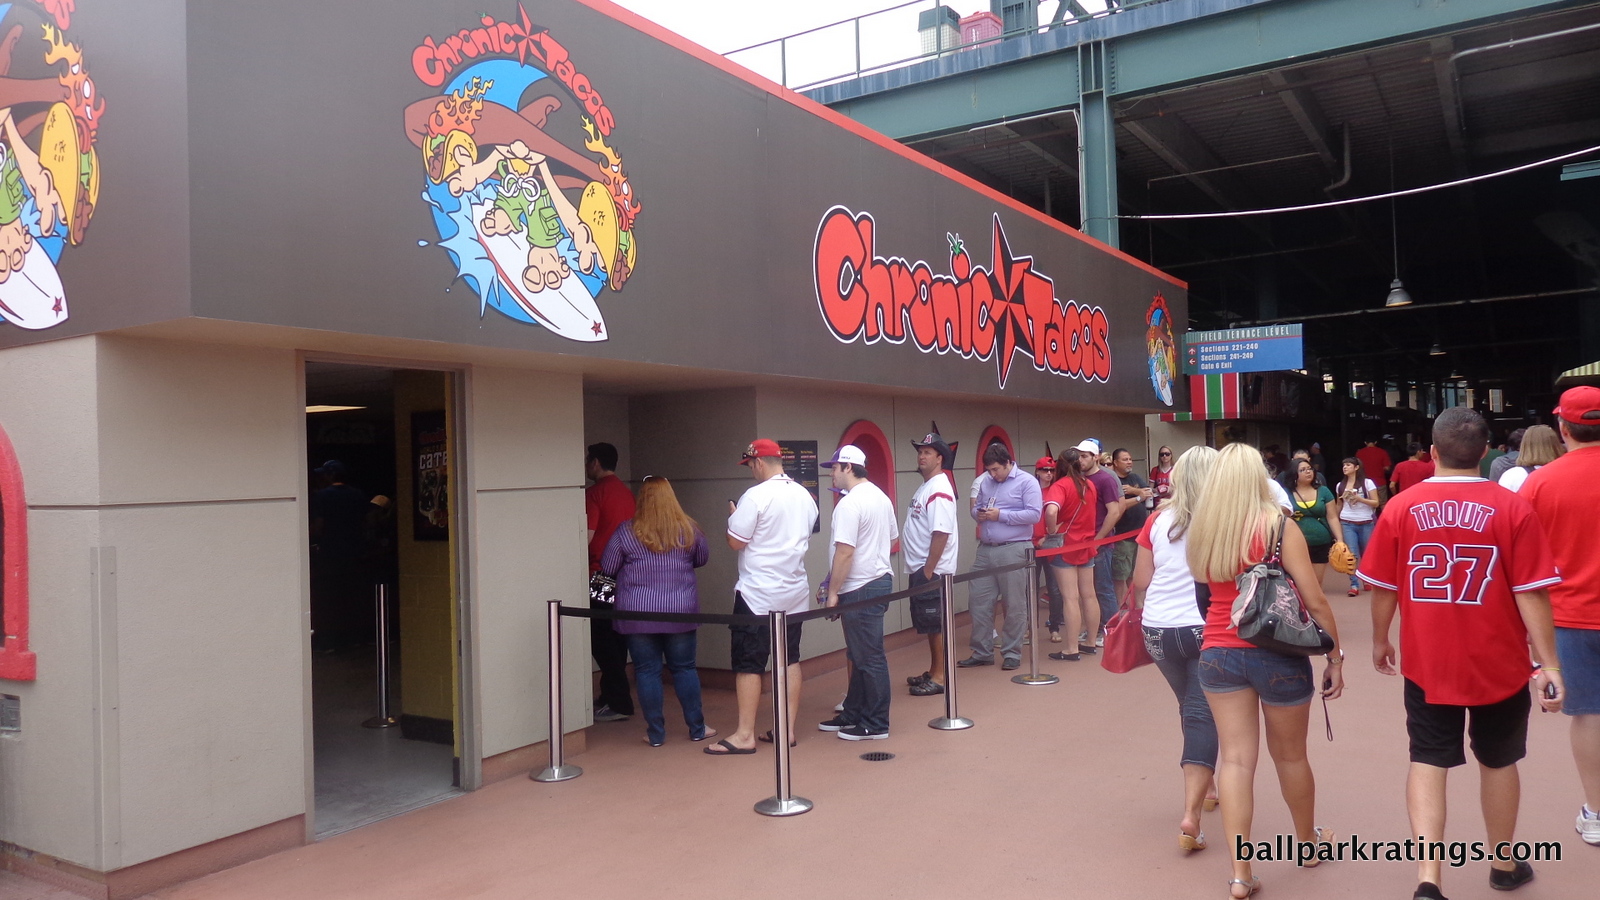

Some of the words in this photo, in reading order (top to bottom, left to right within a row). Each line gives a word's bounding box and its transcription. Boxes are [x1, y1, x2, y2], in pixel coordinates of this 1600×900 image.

[411, 12, 517, 87] Chronic
[540, 31, 616, 137] Tacos
[814, 205, 997, 361] Chronic
[1022, 270, 1111, 383] Tacos
[1200, 331, 1222, 342] FIELD
[1227, 329, 1260, 339] TERRACE
[1265, 326, 1289, 336] LEVEL
[1200, 345, 1229, 353] Sections
[1231, 342, 1259, 351] 221-240
[1200, 354, 1227, 362] Sections
[1220, 361, 1233, 369] Exit
[1409, 499, 1495, 533] TROUT
[1407, 542, 1498, 605] 27
